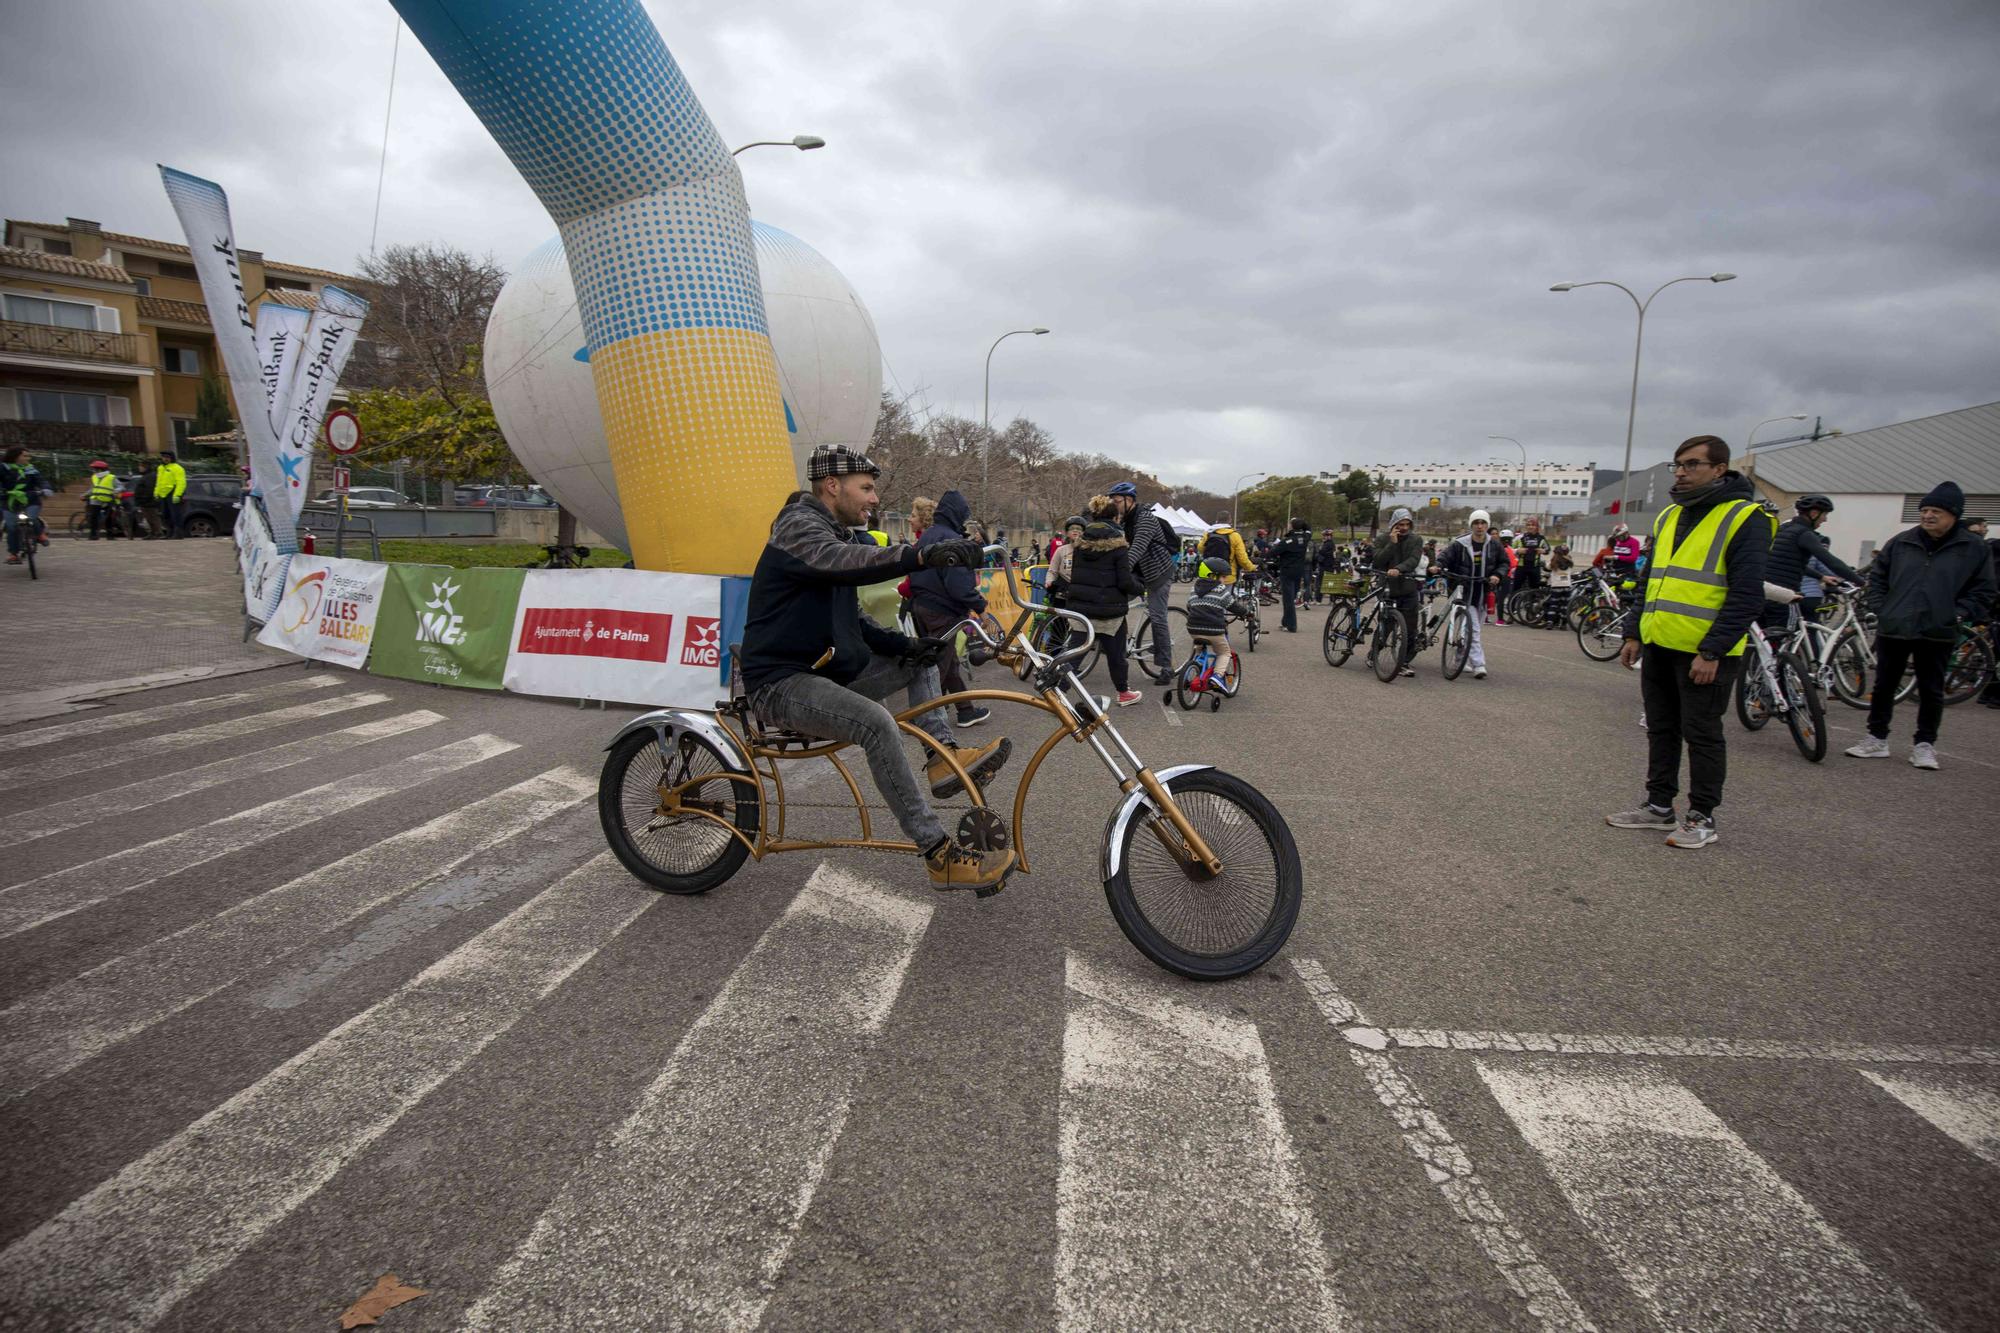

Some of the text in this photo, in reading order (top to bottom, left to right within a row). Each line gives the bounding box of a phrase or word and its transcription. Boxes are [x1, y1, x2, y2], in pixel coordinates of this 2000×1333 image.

[291, 322, 345, 449] CaixaBank
[322, 599, 358, 621] ILLES
[318, 617, 371, 645] BALEARS
[415, 610, 464, 645] IME
[534, 626, 650, 642] Ajuntament de Palma
